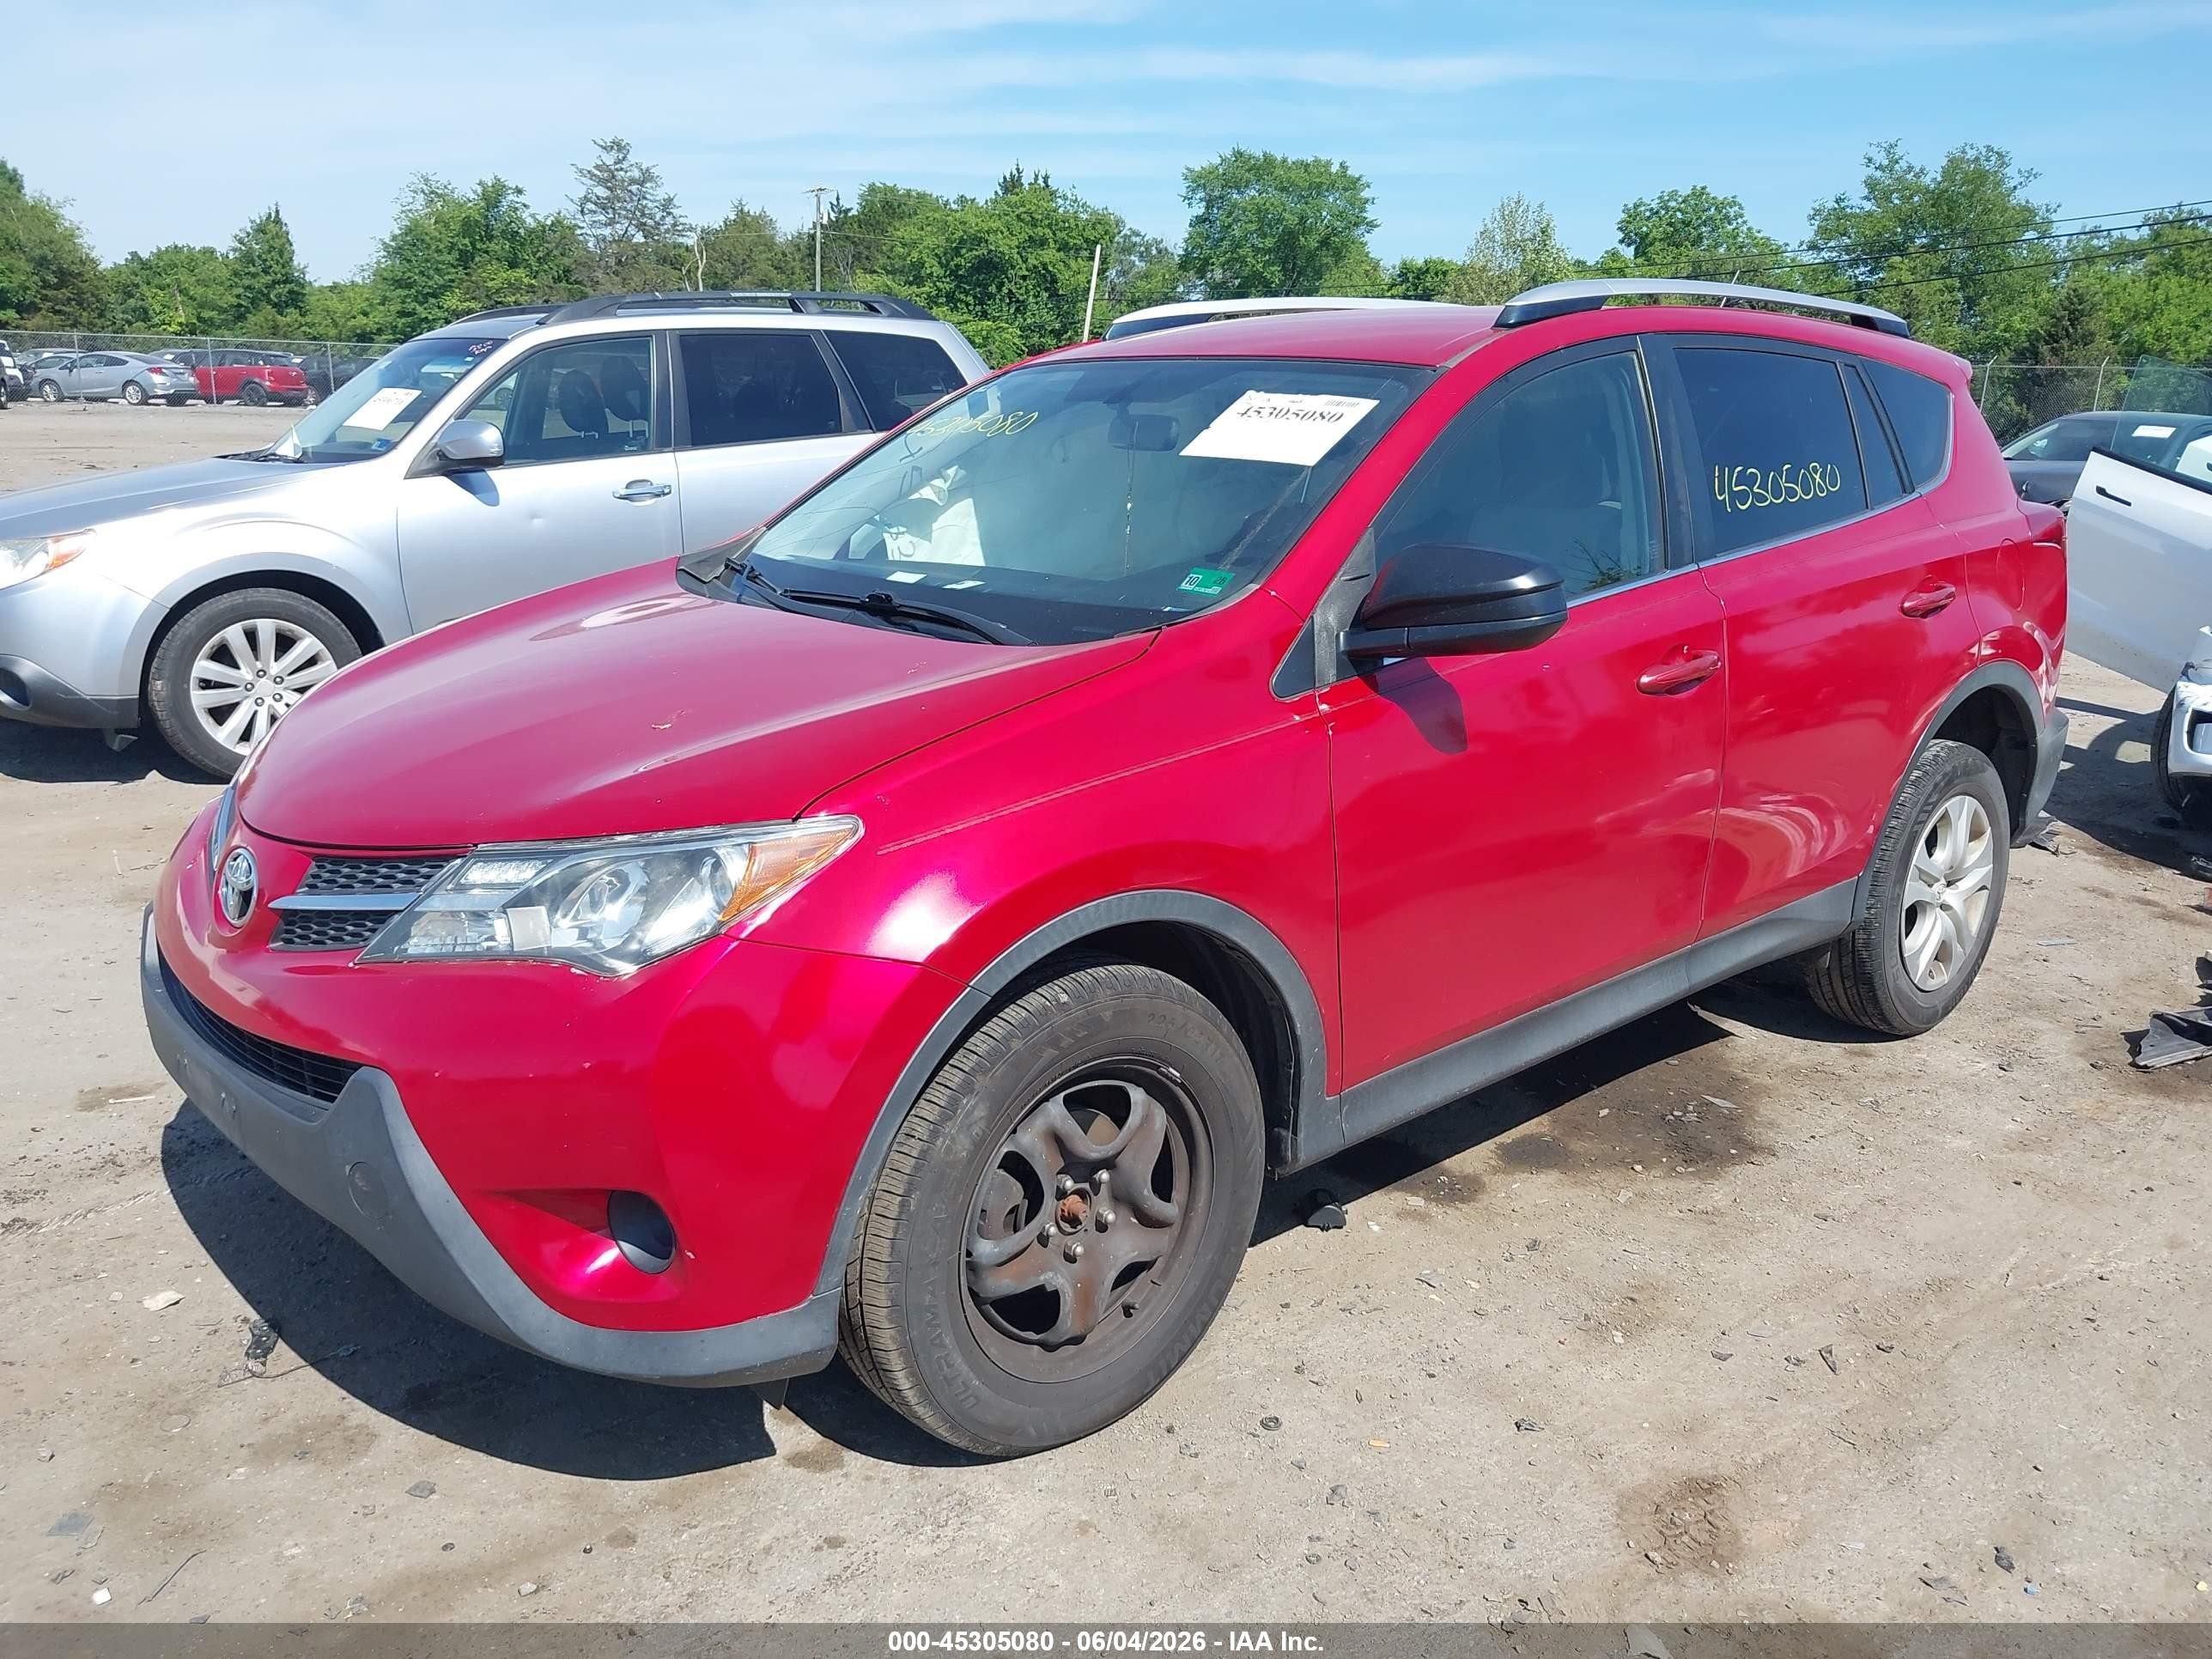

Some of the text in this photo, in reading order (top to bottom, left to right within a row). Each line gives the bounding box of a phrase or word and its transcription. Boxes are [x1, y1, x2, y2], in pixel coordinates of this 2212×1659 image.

[1237, 405, 1345, 423] 45305080
[1715, 462, 1841, 513] 45305080
[1184, 575, 1200, 586] 10
